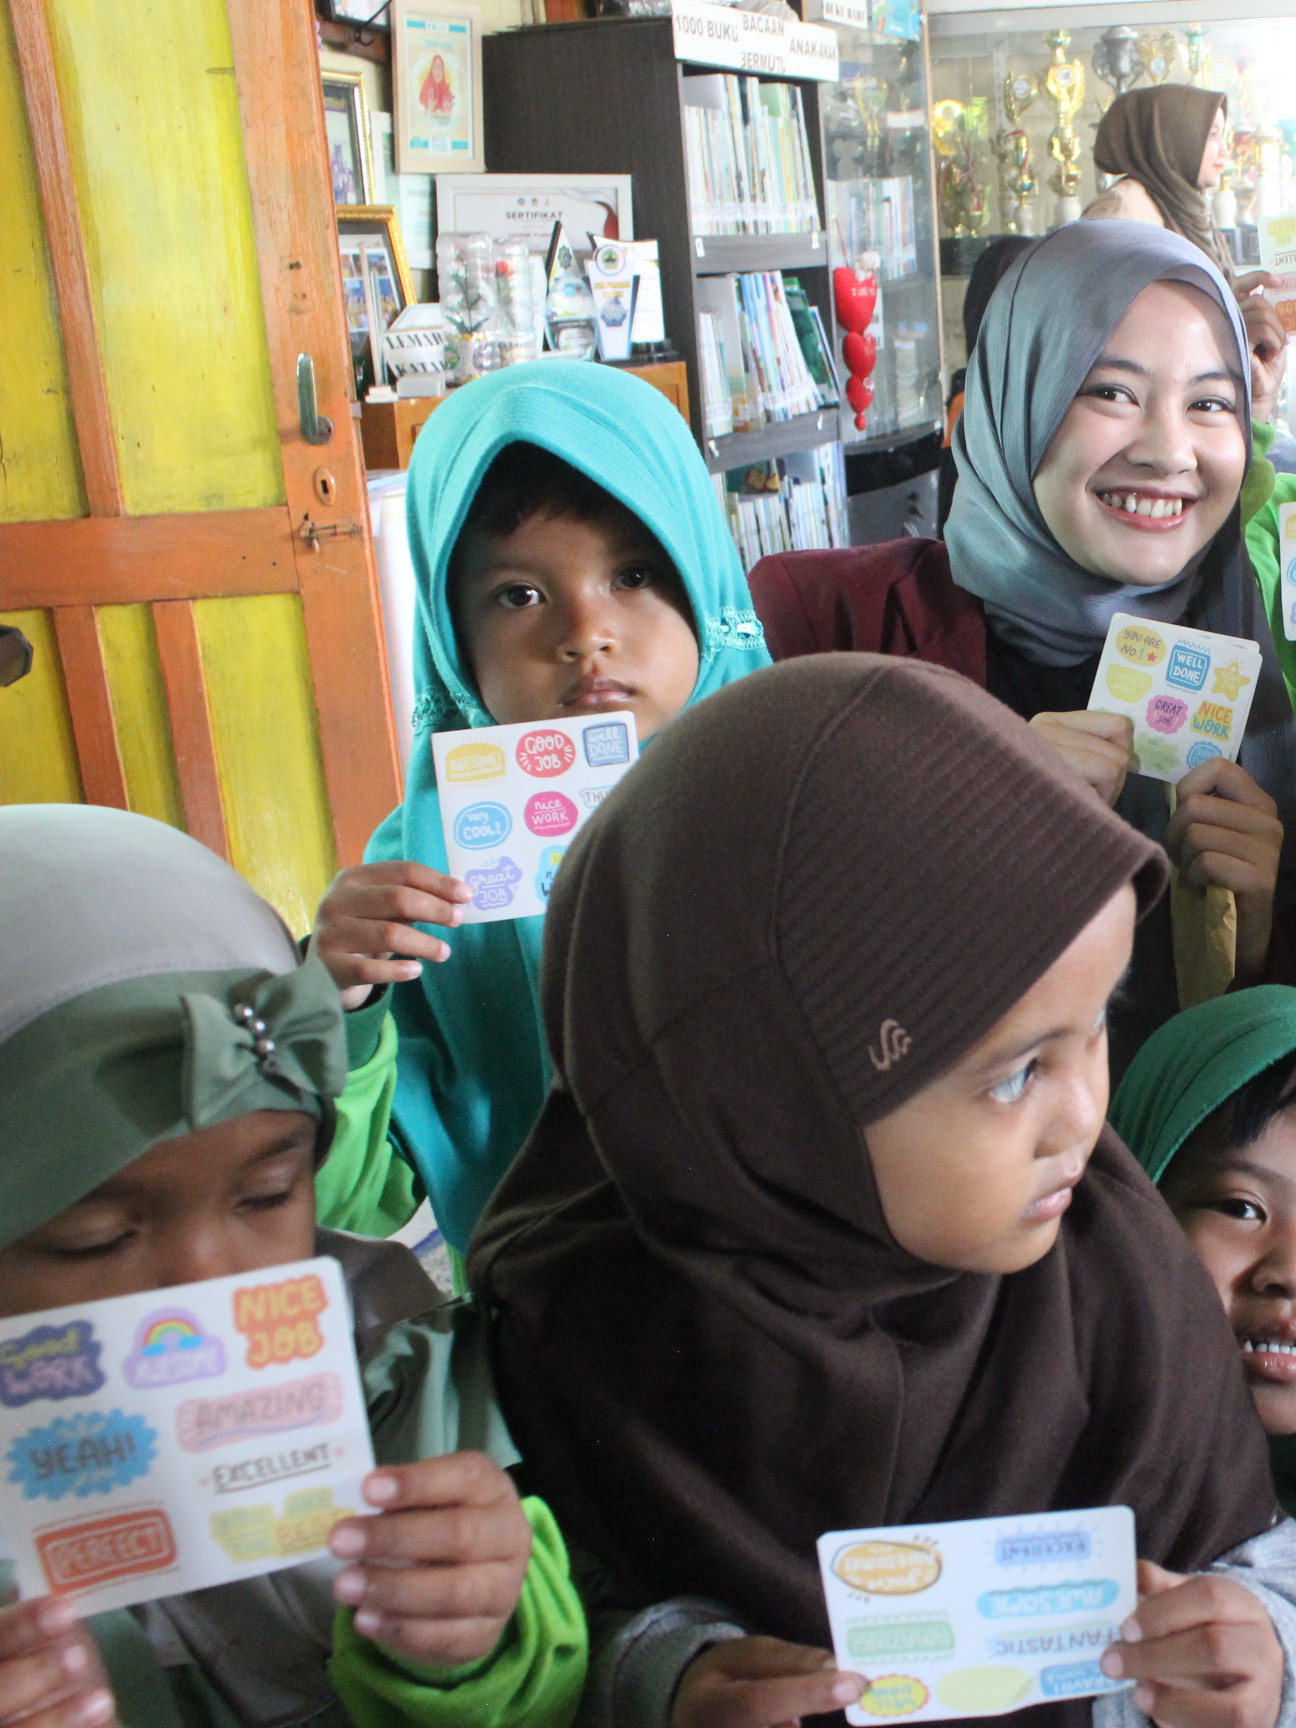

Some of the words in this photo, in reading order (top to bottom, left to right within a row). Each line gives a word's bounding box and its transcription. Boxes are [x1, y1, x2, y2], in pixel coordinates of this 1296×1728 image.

[676, 14, 703, 35] 1000
[707, 21, 738, 42] BUKU
[742, 14, 784, 36] BACAAN
[790, 38, 837, 61] ANAK-ANAK
[741, 51, 787, 73] BERMUTU
[506, 211, 562, 219] SERTIFIKAT
[1123, 628, 1143, 642] YOU
[1144, 636, 1162, 649] ARE
[1120, 644, 1136, 657] NO
[1176, 653, 1204, 669] WELL
[1173, 668, 1200, 684] DONE
[1155, 699, 1183, 716] GREAT
[1199, 703, 1232, 724] NICE
[588, 726, 621, 742] well
[1193, 716, 1229, 739] WORK
[524, 734, 566, 754] GOOD
[587, 740, 623, 755] DONE
[533, 754, 562, 772] JOB
[534, 799, 563, 810] nice
[465, 812, 489, 824] very
[531, 811, 569, 825] WORK
[463, 821, 501, 841] COOL!
[468, 864, 516, 894] great
[478, 885, 509, 902] JOB
[238, 1278, 321, 1323] NICE
[254, 1321, 321, 1362] JOB
[196, 1383, 326, 1429] AMAZING
[30, 1433, 137, 1481] YEAH!
[211, 1444, 332, 1489] EXCELLENT
[991, 1586, 1105, 1616] AWESOME
[996, 1626, 1121, 1656] FANTASTIC
